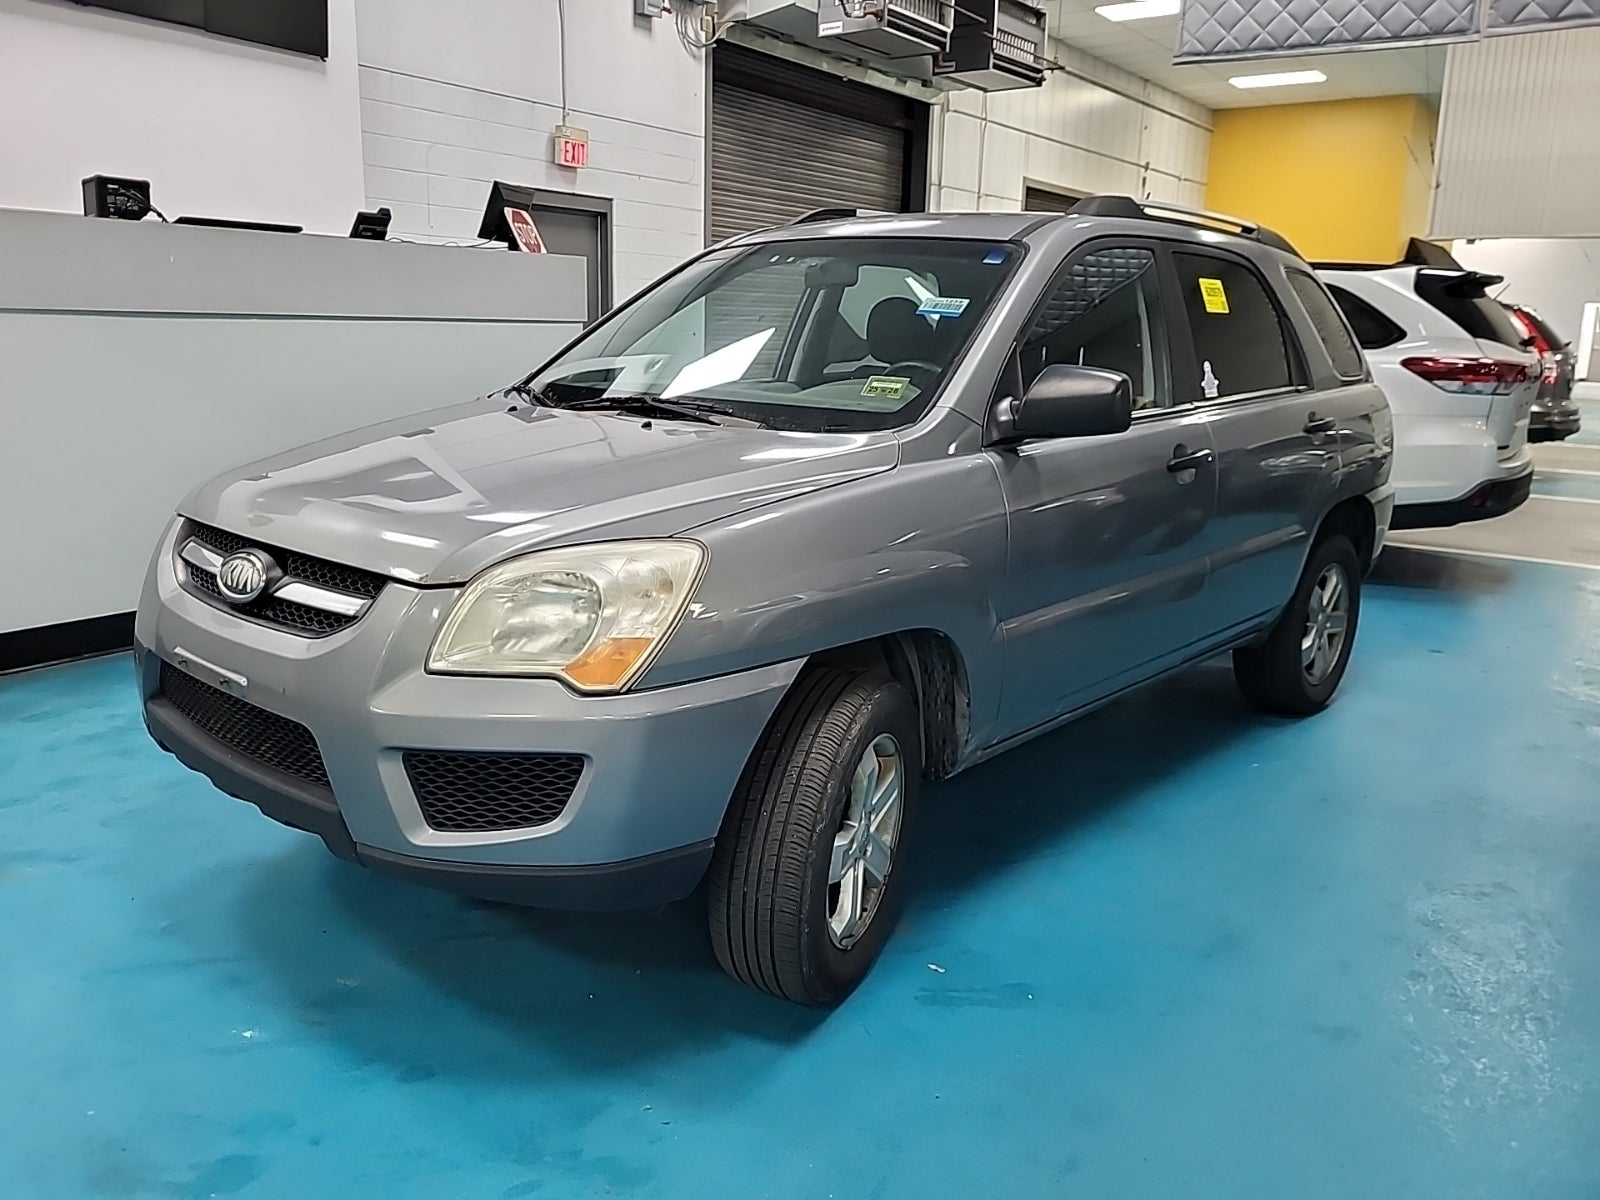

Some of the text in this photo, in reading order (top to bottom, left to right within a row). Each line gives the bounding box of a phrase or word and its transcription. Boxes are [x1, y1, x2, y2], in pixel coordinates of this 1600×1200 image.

[564, 140, 585, 165] EXIT
[514, 221, 538, 245] STOP
[223, 559, 254, 592] KIA
